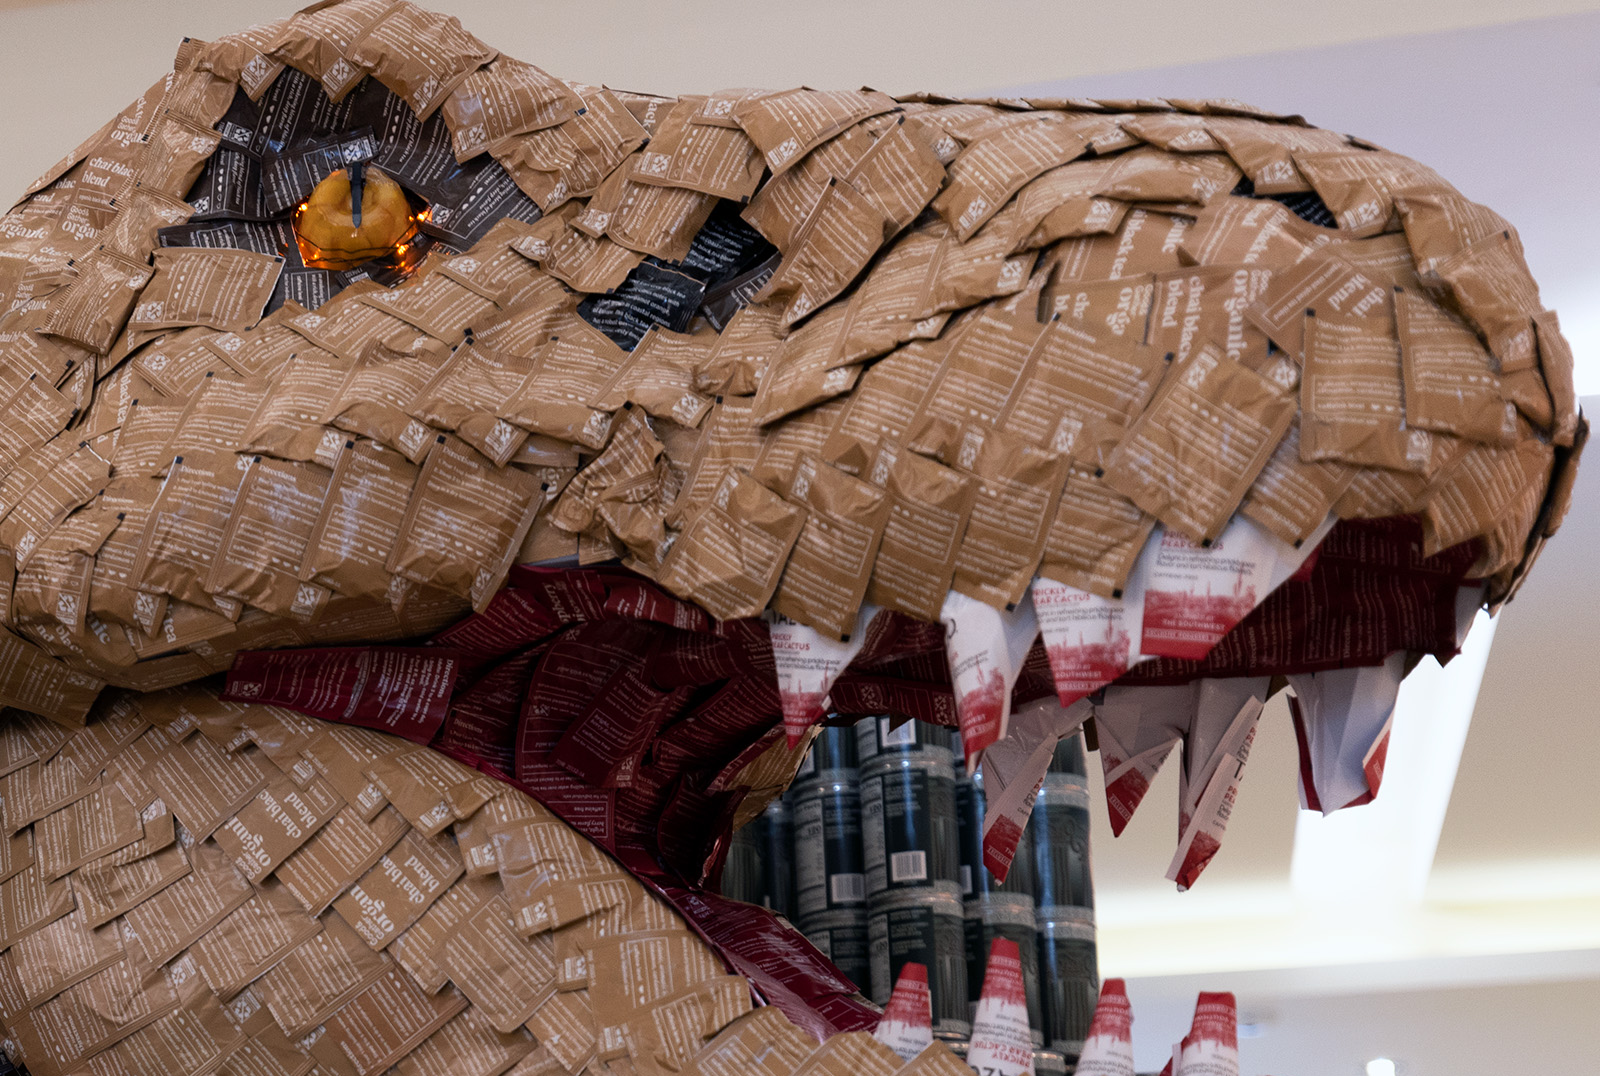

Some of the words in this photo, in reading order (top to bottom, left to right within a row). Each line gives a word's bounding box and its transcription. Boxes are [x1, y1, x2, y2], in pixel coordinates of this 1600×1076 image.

[82, 170, 110, 187] blend
[89, 157, 114, 171] chai
[111, 162, 135, 177] blac
[62, 220, 98, 241] orga
[11, 299, 50, 316] organic
[1163, 279, 1185, 328] blend
[1186, 276, 1206, 313] chai
[1329, 273, 1372, 311] blend
[1347, 286, 1386, 319] chai
[1106, 286, 1133, 336] orga
[1224, 269, 1250, 361] organic
[1177, 313, 1203, 363] black
[1055, 593, 1091, 603] CACTUS
[437, 659, 454, 699] Directions
[257, 789, 282, 818] blac
[284, 792, 317, 829] blend
[224, 816, 271, 867] organi
[274, 812, 302, 839] chai
[235, 856, 255, 879] Good&
[380, 855, 403, 883] bla
[404, 854, 440, 893] blend
[396, 876, 425, 904] chai
[350, 884, 394, 932] organ
[355, 920, 378, 946] Good&
